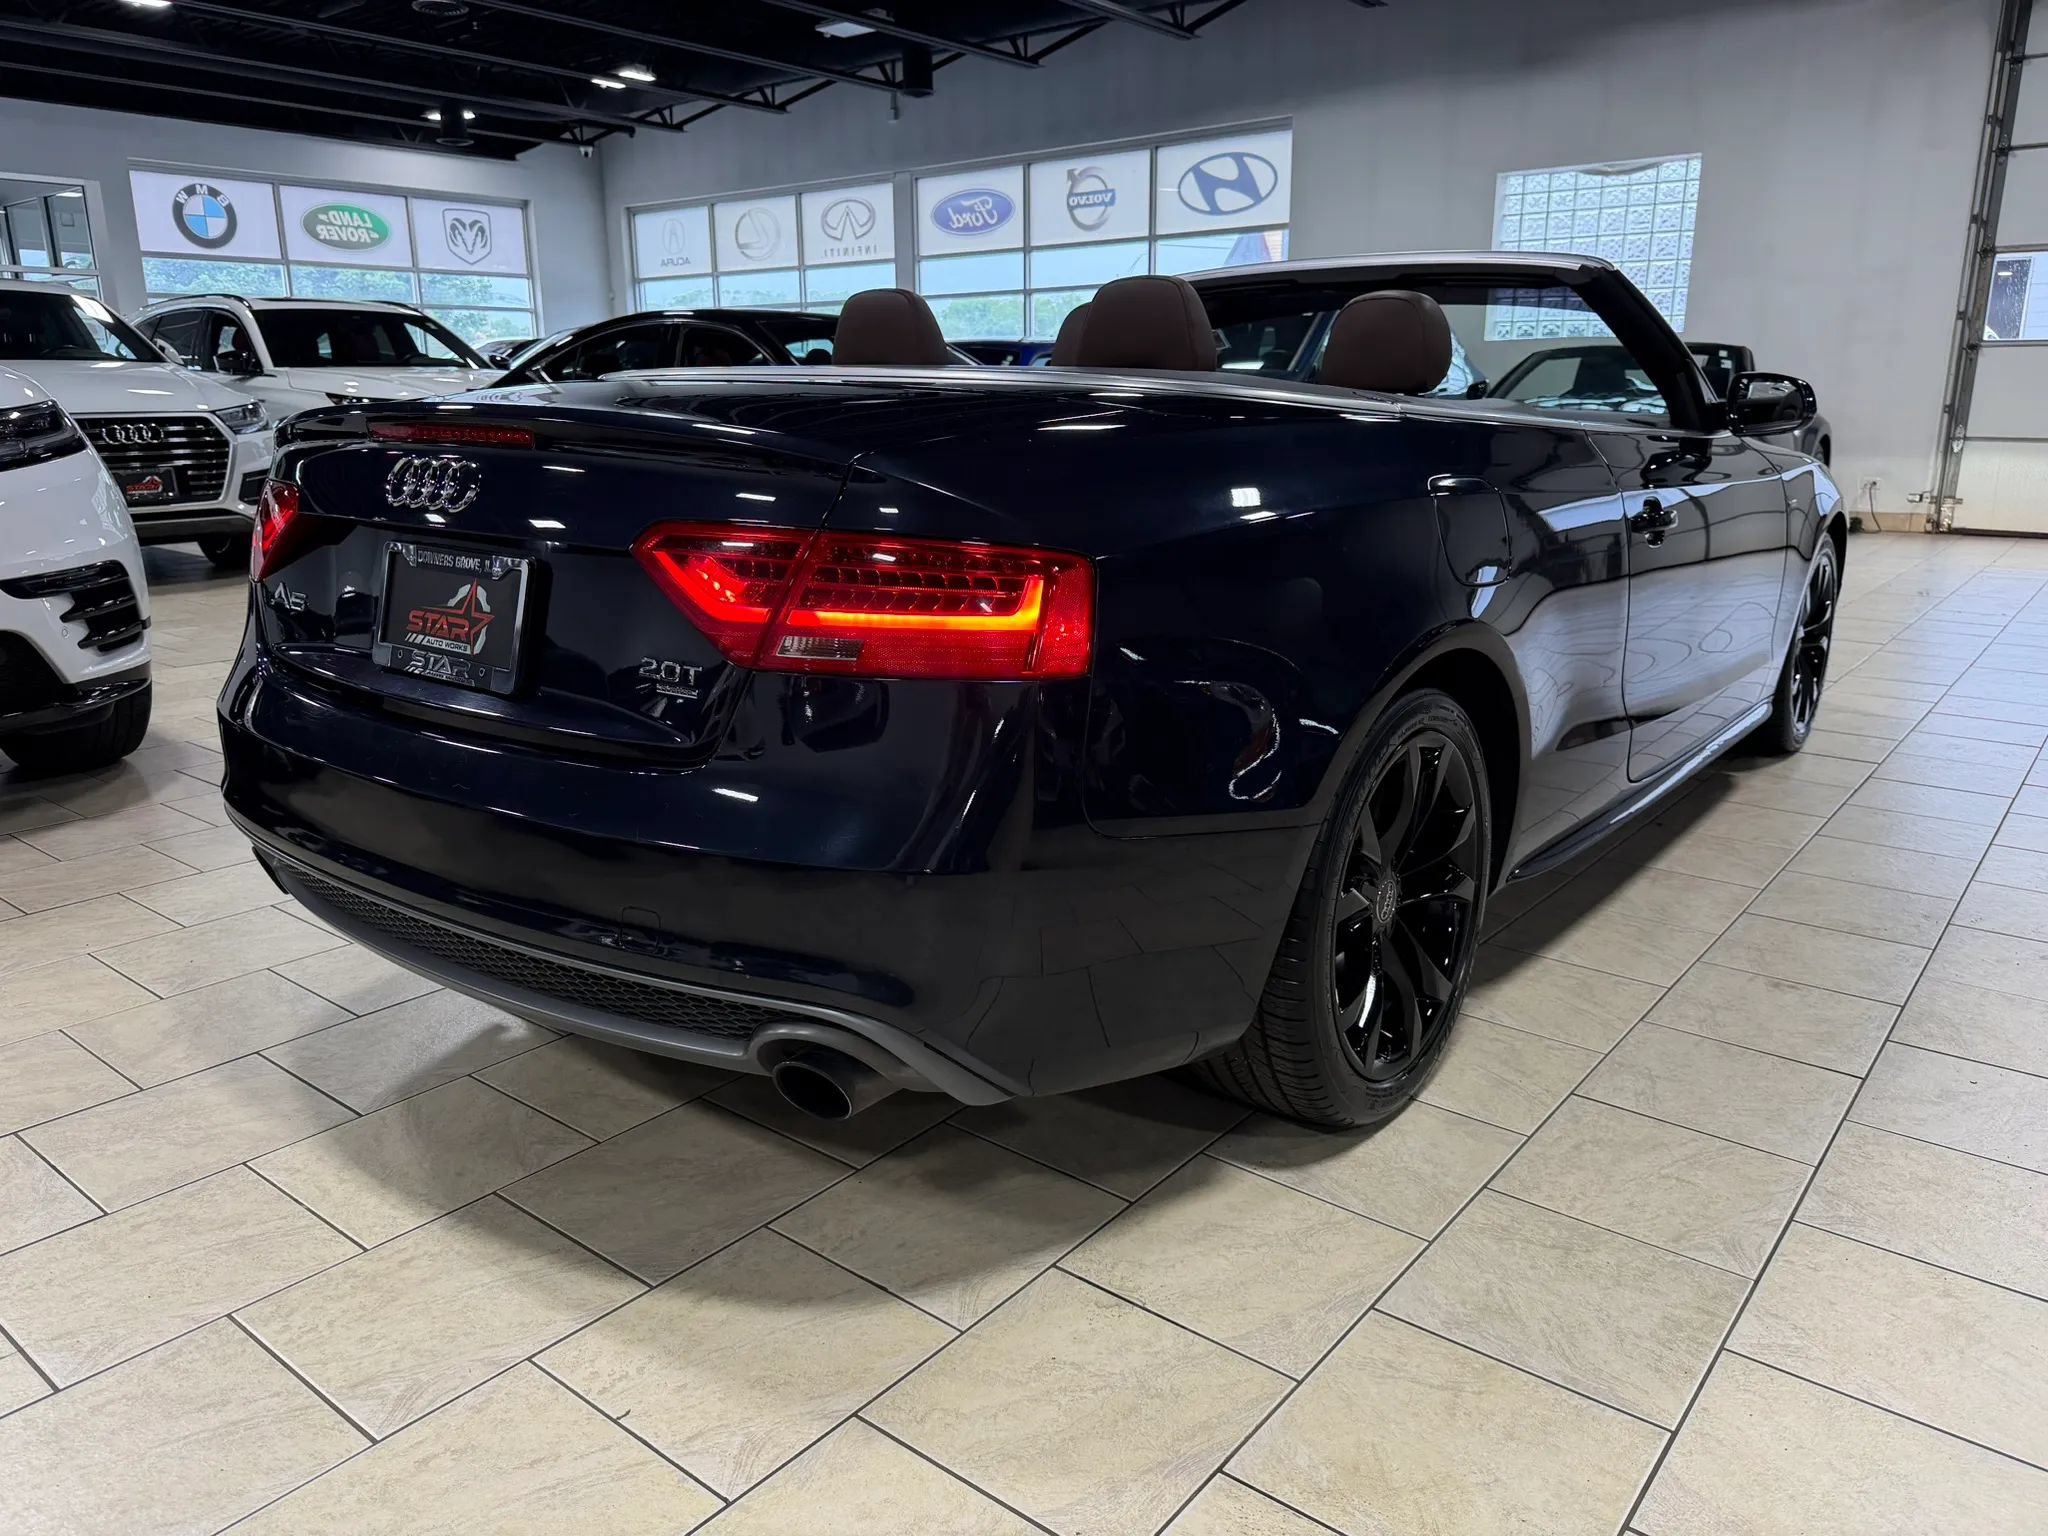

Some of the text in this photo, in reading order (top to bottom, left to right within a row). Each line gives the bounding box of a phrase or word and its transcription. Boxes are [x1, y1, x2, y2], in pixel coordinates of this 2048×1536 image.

[417, 550, 454, 567] DOWNERS
[405, 609, 471, 642] STAR
[425, 638, 469, 652] AUTO WORKS
[410, 649, 471, 680] STAR
